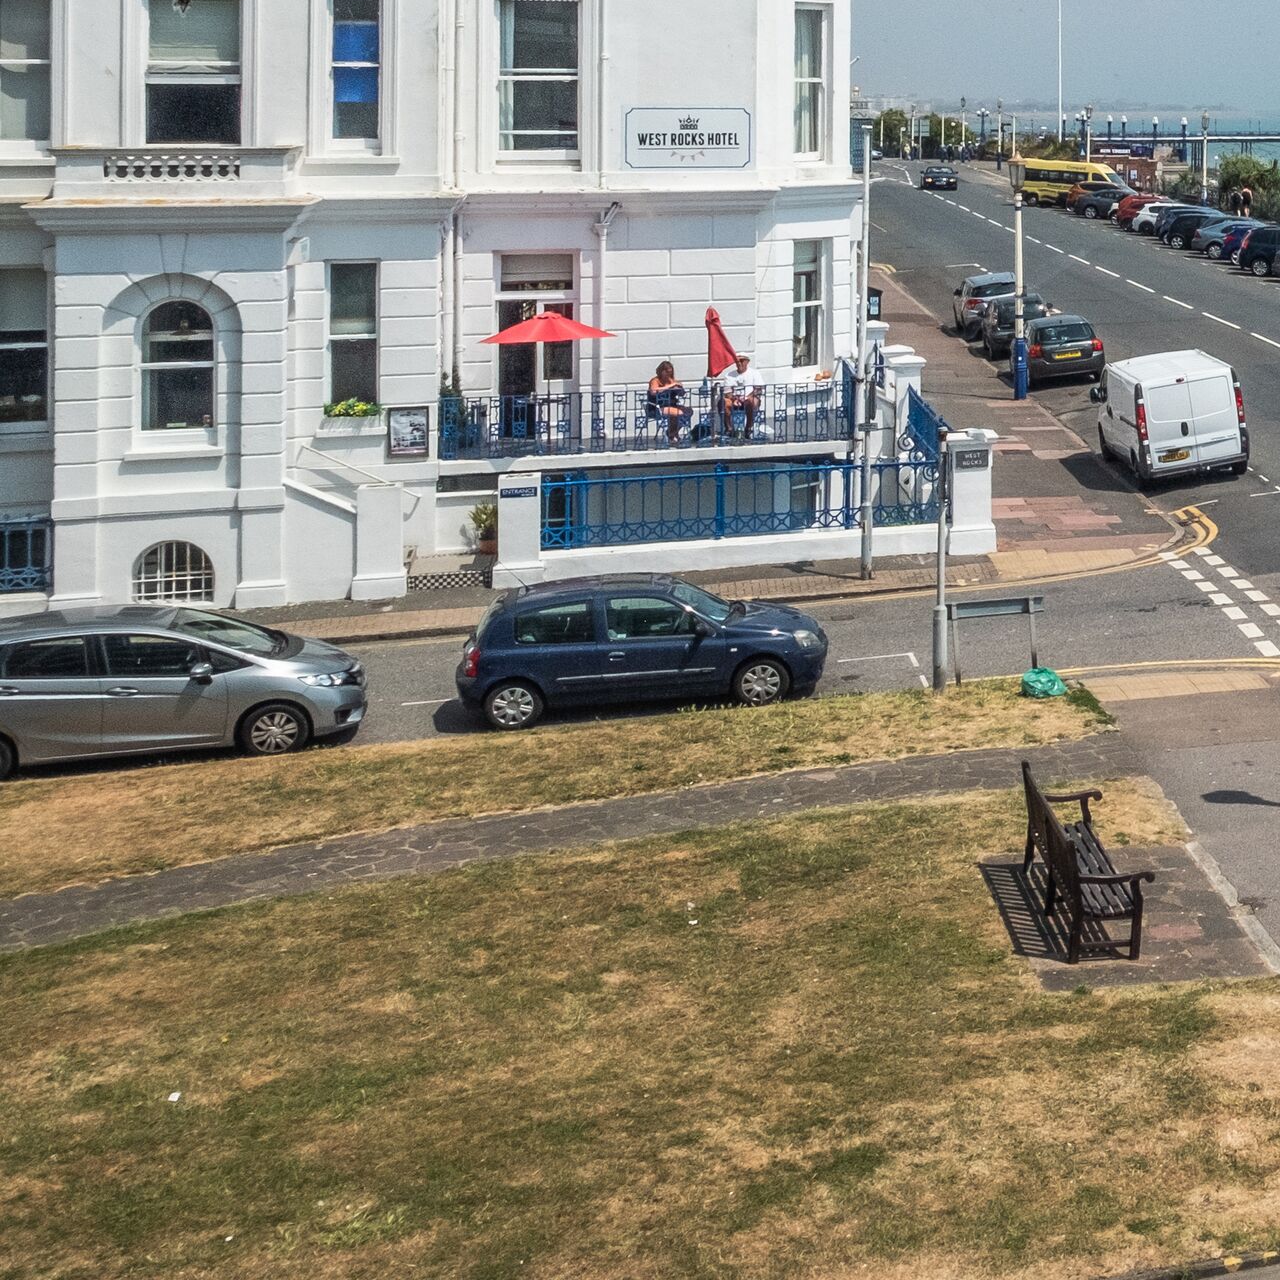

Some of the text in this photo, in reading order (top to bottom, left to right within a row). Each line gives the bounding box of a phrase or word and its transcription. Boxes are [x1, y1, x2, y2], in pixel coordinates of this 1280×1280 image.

[637, 132, 740, 146] WEST ROCKS HOTEL
